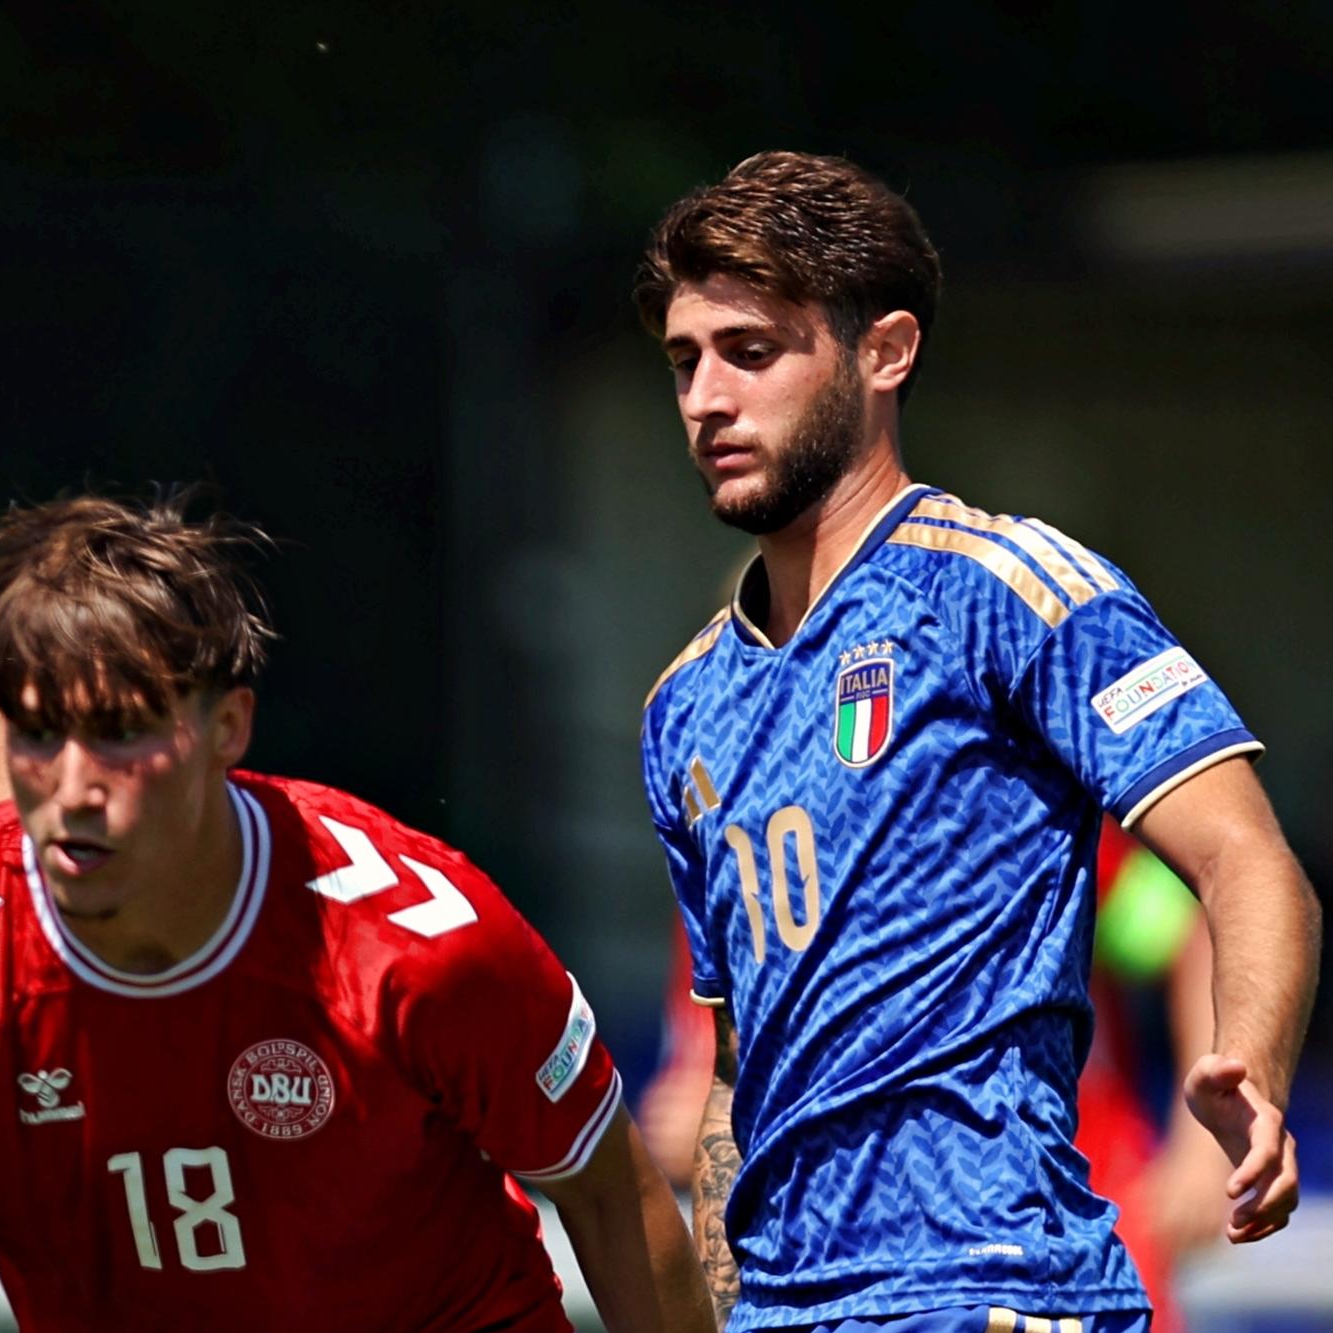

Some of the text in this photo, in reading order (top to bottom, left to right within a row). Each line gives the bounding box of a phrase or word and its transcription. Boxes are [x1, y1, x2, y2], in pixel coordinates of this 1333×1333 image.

[840, 667, 888, 696] ITALIA
[724, 805, 821, 965] 10
[232, 1065, 256, 1123] DANSK
[308, 1074, 331, 1126] UNION
[250, 1072, 312, 1105] DBU
[261, 1122, 302, 1136] 1889
[106, 1146, 246, 1271] 18
